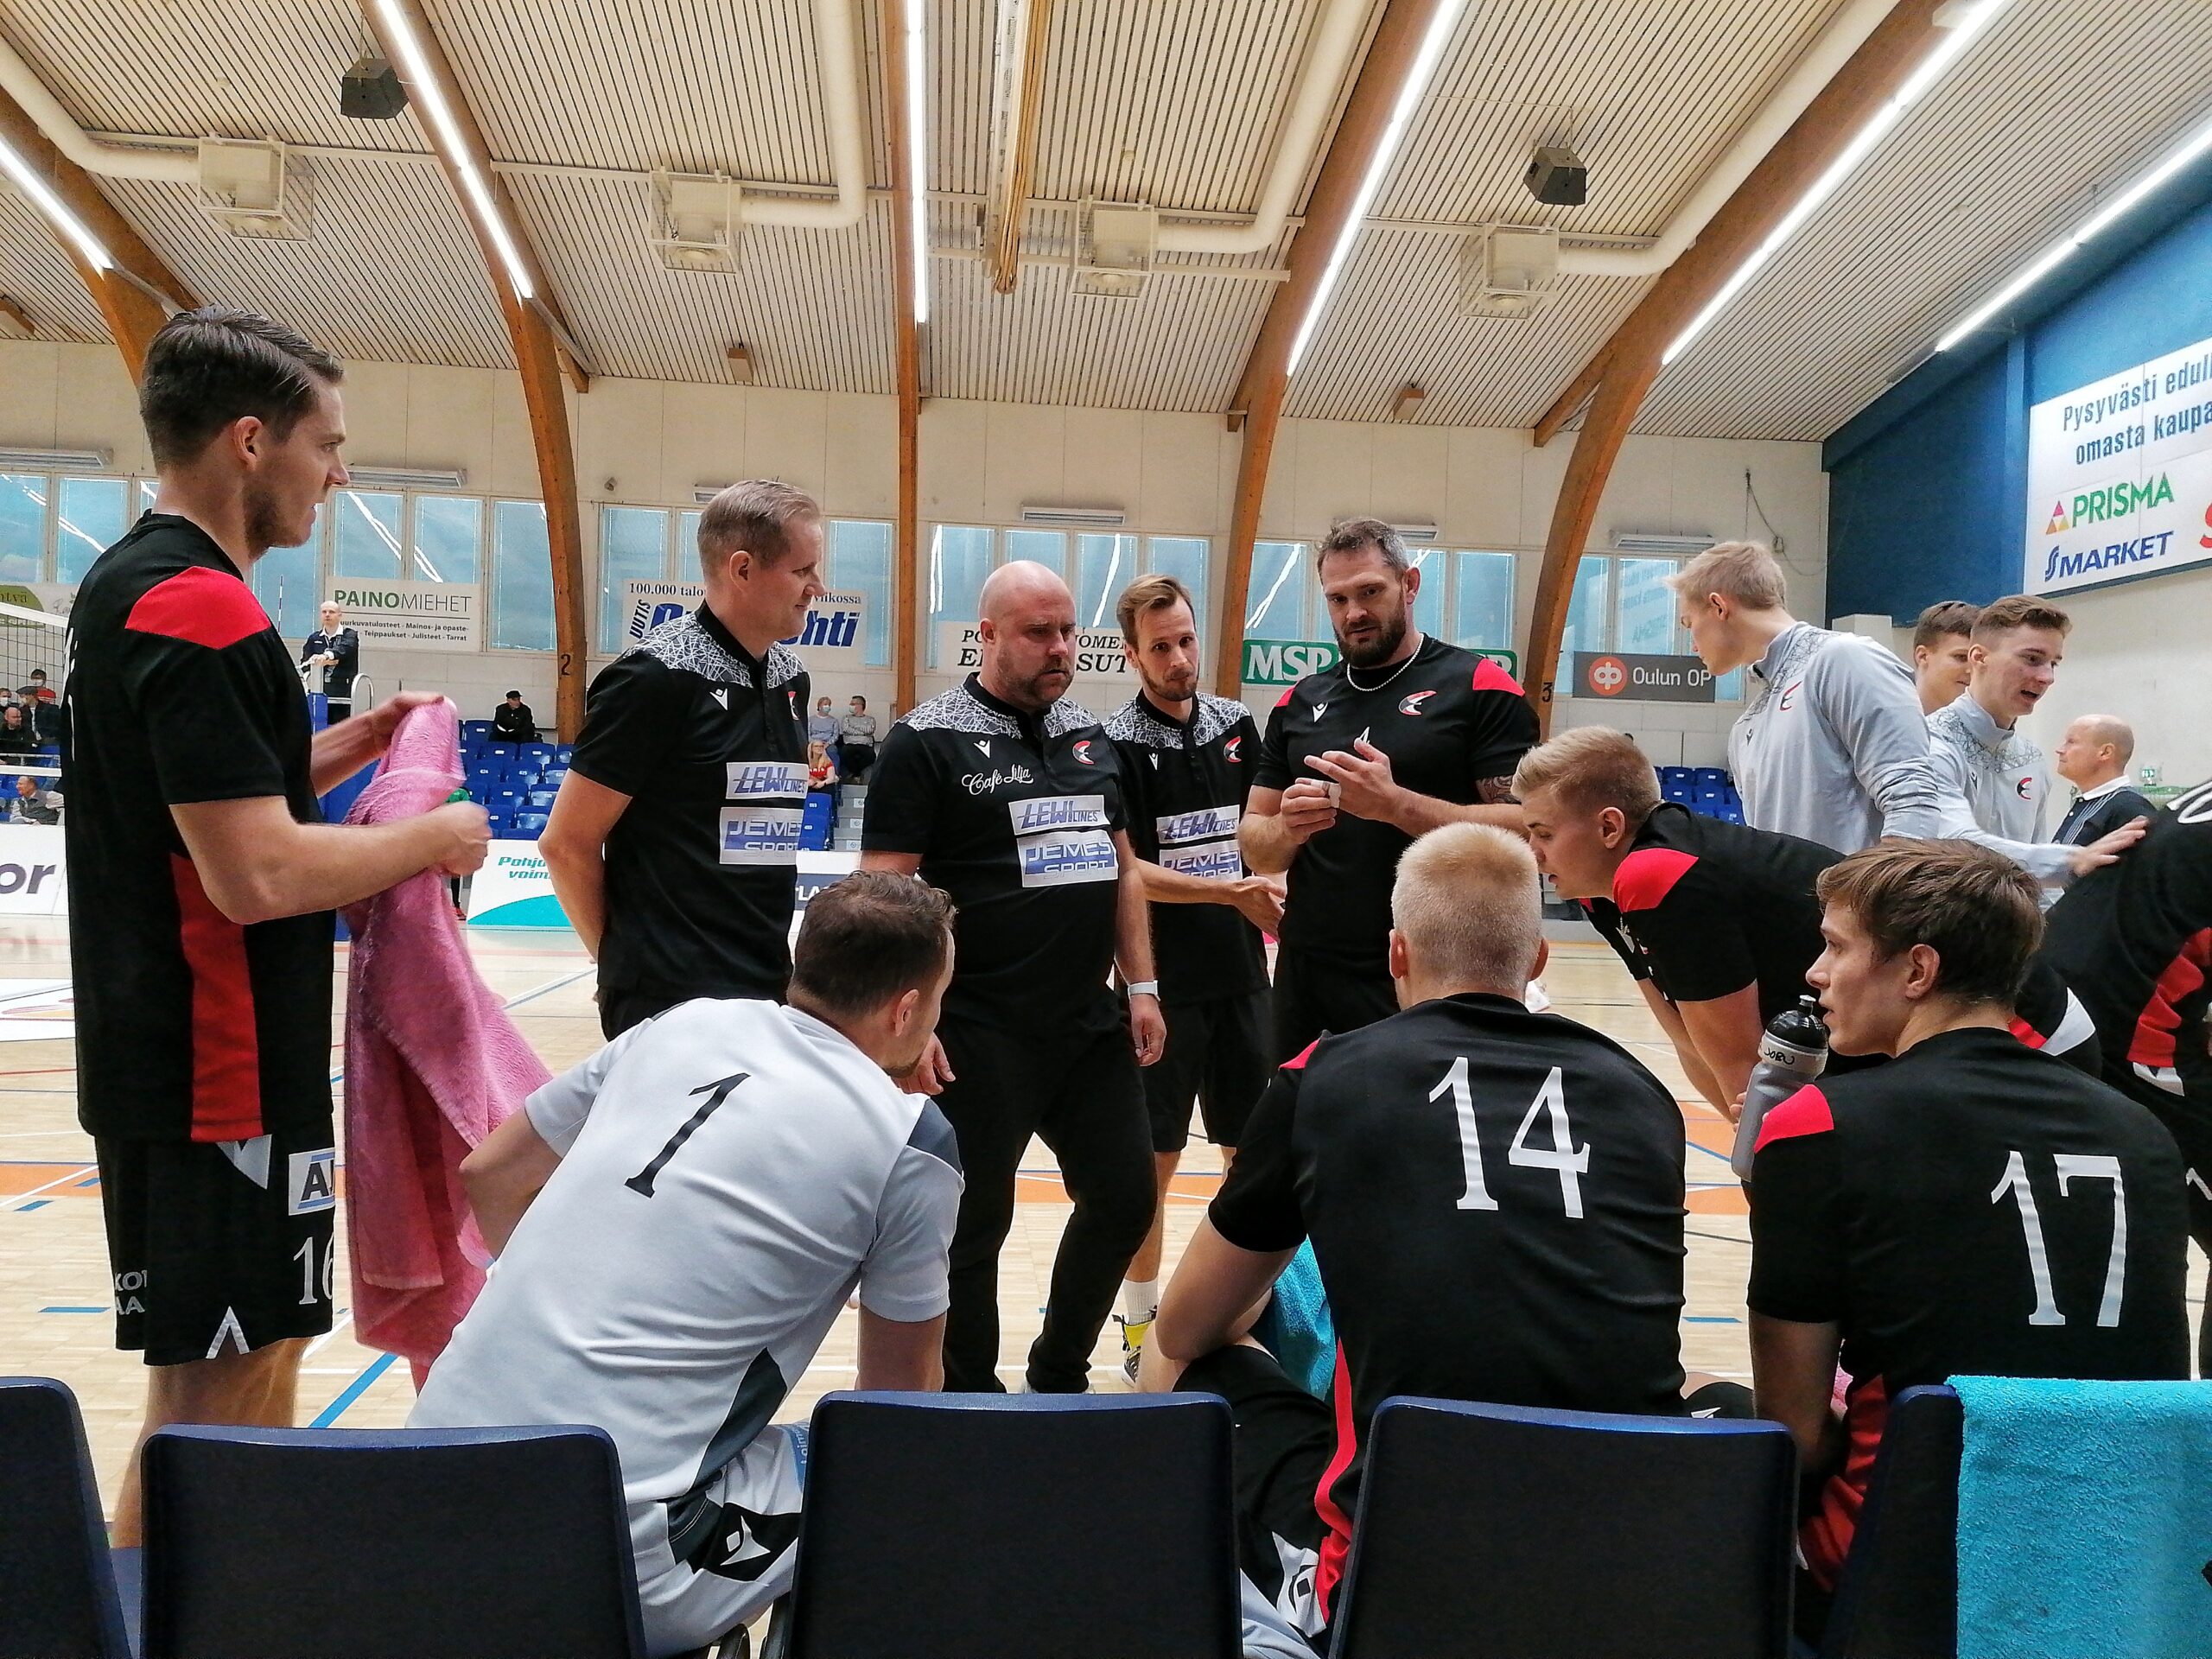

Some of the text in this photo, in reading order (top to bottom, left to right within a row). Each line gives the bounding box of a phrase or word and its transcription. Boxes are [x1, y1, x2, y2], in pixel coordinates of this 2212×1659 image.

[2063, 374, 2158, 432] Pysyvästi
[2076, 424, 2145, 465] omasta
[2072, 472, 2175, 529] PRISMA
[334, 589, 472, 613] PAINOMIEHET
[629, 582, 677, 595] 100.000
[681, 585, 706, 596] talo
[340, 620, 400, 629] uurkuvatulosteet
[629, 599, 652, 639] UUTIS
[364, 630, 406, 639] Teippaukset
[561, 654, 571, 676] 2
[1246, 645, 1332, 683] MSP
[1632, 667, 1713, 687] Oulun OP
[962, 769, 1002, 795] Café
[1027, 838, 1112, 862] JEMES
[509, 869, 551, 880] voim
[1044, 861, 1109, 880] SPORT
[624, 1072, 751, 1198] 1
[1428, 1057, 1590, 1219] 14
[1991, 1150, 2127, 1328] 17
